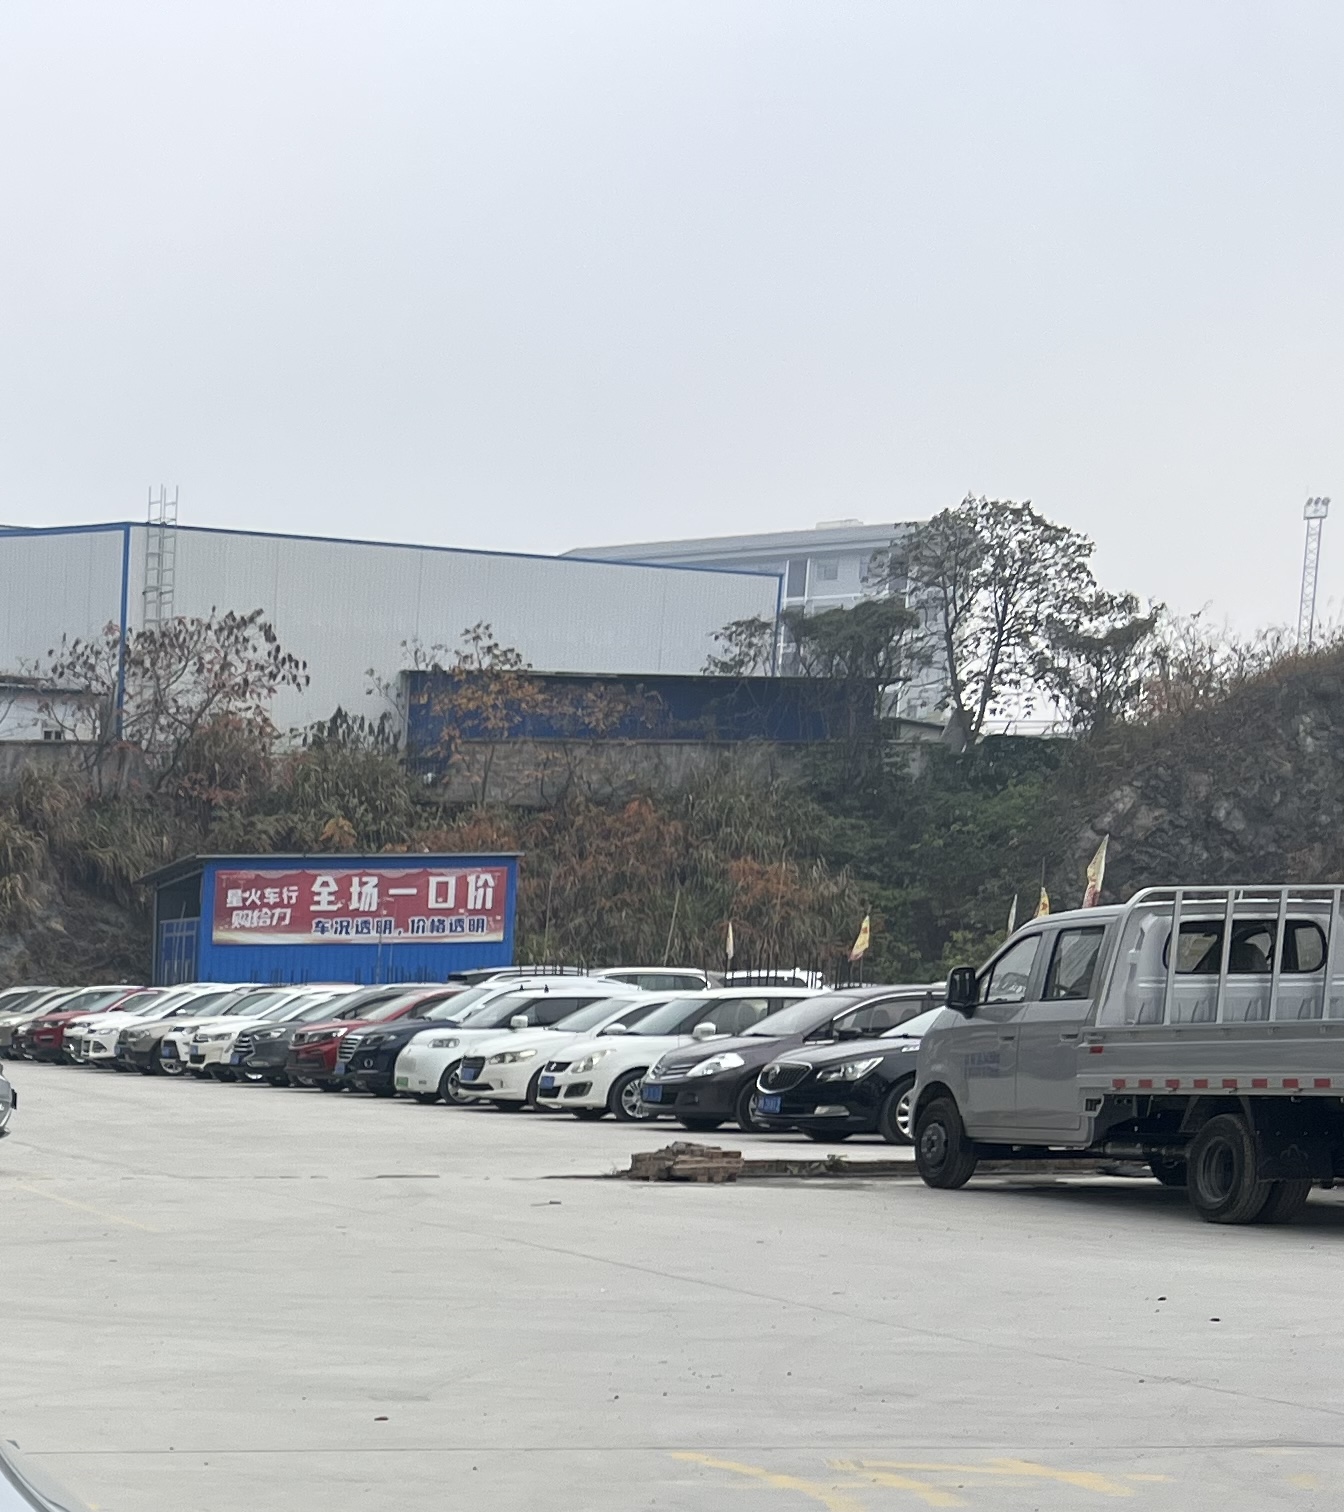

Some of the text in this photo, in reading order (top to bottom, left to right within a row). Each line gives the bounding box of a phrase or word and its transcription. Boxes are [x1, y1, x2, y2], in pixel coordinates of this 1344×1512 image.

[226, 886, 298, 907] 星火车行
[310, 873, 495, 912] 全场一口价
